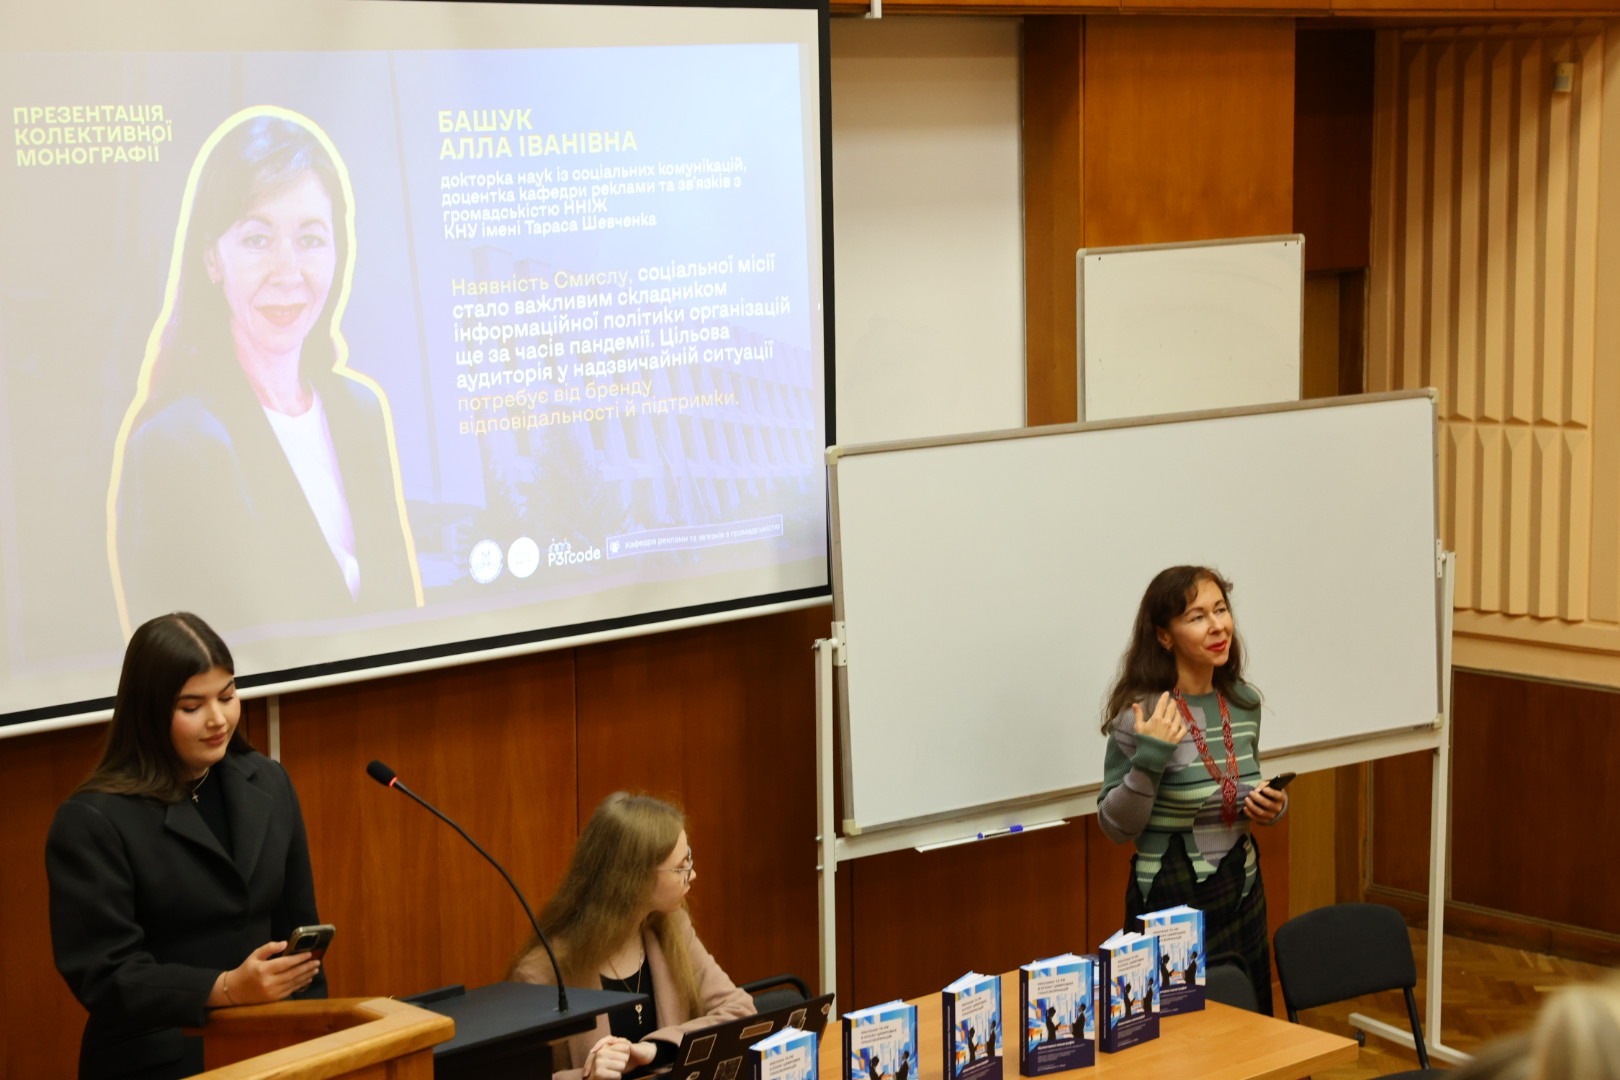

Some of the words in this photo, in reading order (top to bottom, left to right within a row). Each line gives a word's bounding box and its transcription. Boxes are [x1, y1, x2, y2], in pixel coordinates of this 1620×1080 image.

[13, 105, 163, 124] ПРЕЗЕНТАЦІЯ
[438, 108, 533, 133] БАШУК
[15, 120, 172, 146] КОЛЕКТИВНОЇ
[440, 135, 512, 160] АЛЛА
[520, 130, 638, 157] ІВАНІВНА
[17, 140, 160, 166] МОНОГРАФІЇ
[441, 170, 513, 190] докторка
[518, 167, 552, 187] наук
[556, 165, 568, 182] із
[573, 164, 654, 183] соціальних
[658, 156, 747, 179] комунікацій,
[442, 187, 515, 207] доцентка
[519, 183, 587, 204] кафедри
[592, 179, 655, 199] реклами
[658, 180, 674, 193] та
[443, 200, 559, 223] громадськістю
[564, 198, 607, 215] ННІЖ
[444, 222, 478, 240] КНУ
[482, 219, 520, 238] імені
[525, 218, 578, 236] Тараса
[582, 212, 657, 231] Шевченка
[451, 274, 548, 296] Наявність
[554, 269, 632, 291] Смислу,
[638, 255, 734, 281] соціальної
[738, 253, 776, 273] місії
[452, 301, 509, 319] стало
[515, 290, 614, 314] важливим
[618, 281, 727, 306] складником
[454, 312, 599, 343] інформаційної
[603, 309, 684, 331] політики
[689, 298, 791, 321] організацій
[456, 348, 484, 366] ще
[488, 347, 511, 362] за
[515, 341, 564, 360] часів
[570, 330, 654, 356] пандемії.
[660, 324, 730, 347] Цільова
[456, 364, 552, 391] аудиторія
[557, 363, 568, 383] у
[574, 345, 698, 377] надзвичайній
[703, 340, 774, 363] ситуації
[458, 388, 548, 412] потребує
[554, 383, 580, 403] від
[586, 380, 652, 400] бренду
[459, 403, 620, 435] відповідальності
[625, 396, 636, 416] й
[642, 390, 739, 415] підтримки.
